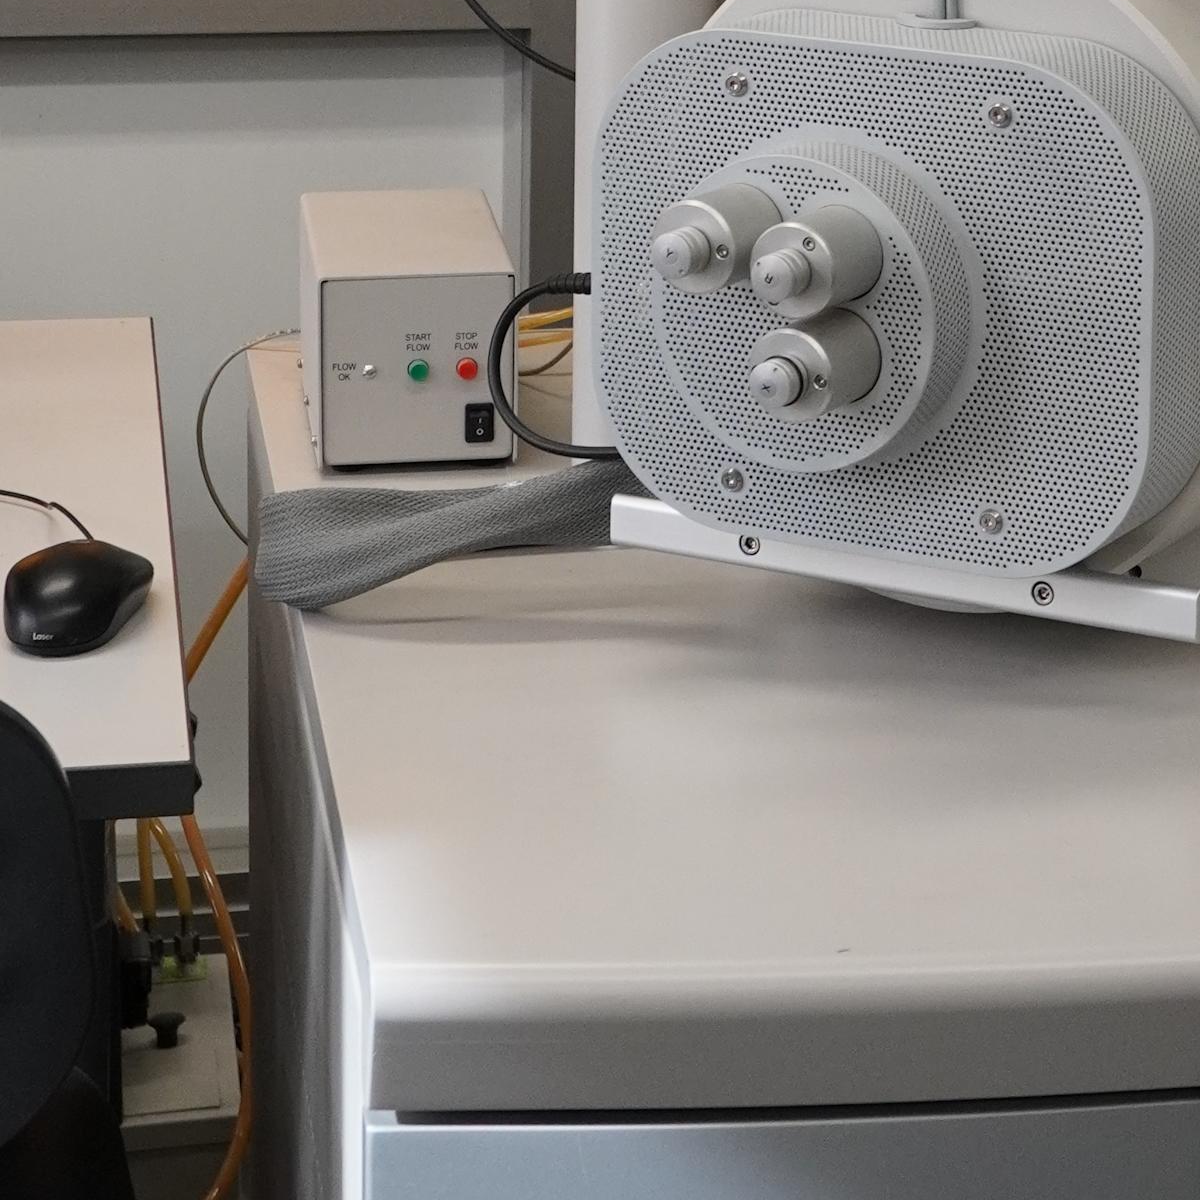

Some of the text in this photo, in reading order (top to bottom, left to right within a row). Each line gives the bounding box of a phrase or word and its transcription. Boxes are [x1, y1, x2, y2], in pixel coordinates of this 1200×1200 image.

[405, 333, 431, 342] START
[455, 332, 478, 341] STOP
[406, 343, 431, 352] FLOW
[454, 342, 479, 351] FLOW
[332, 363, 357, 372] FLOW
[338, 372, 351, 381] OK
[32, 632, 54, 641] Laser
